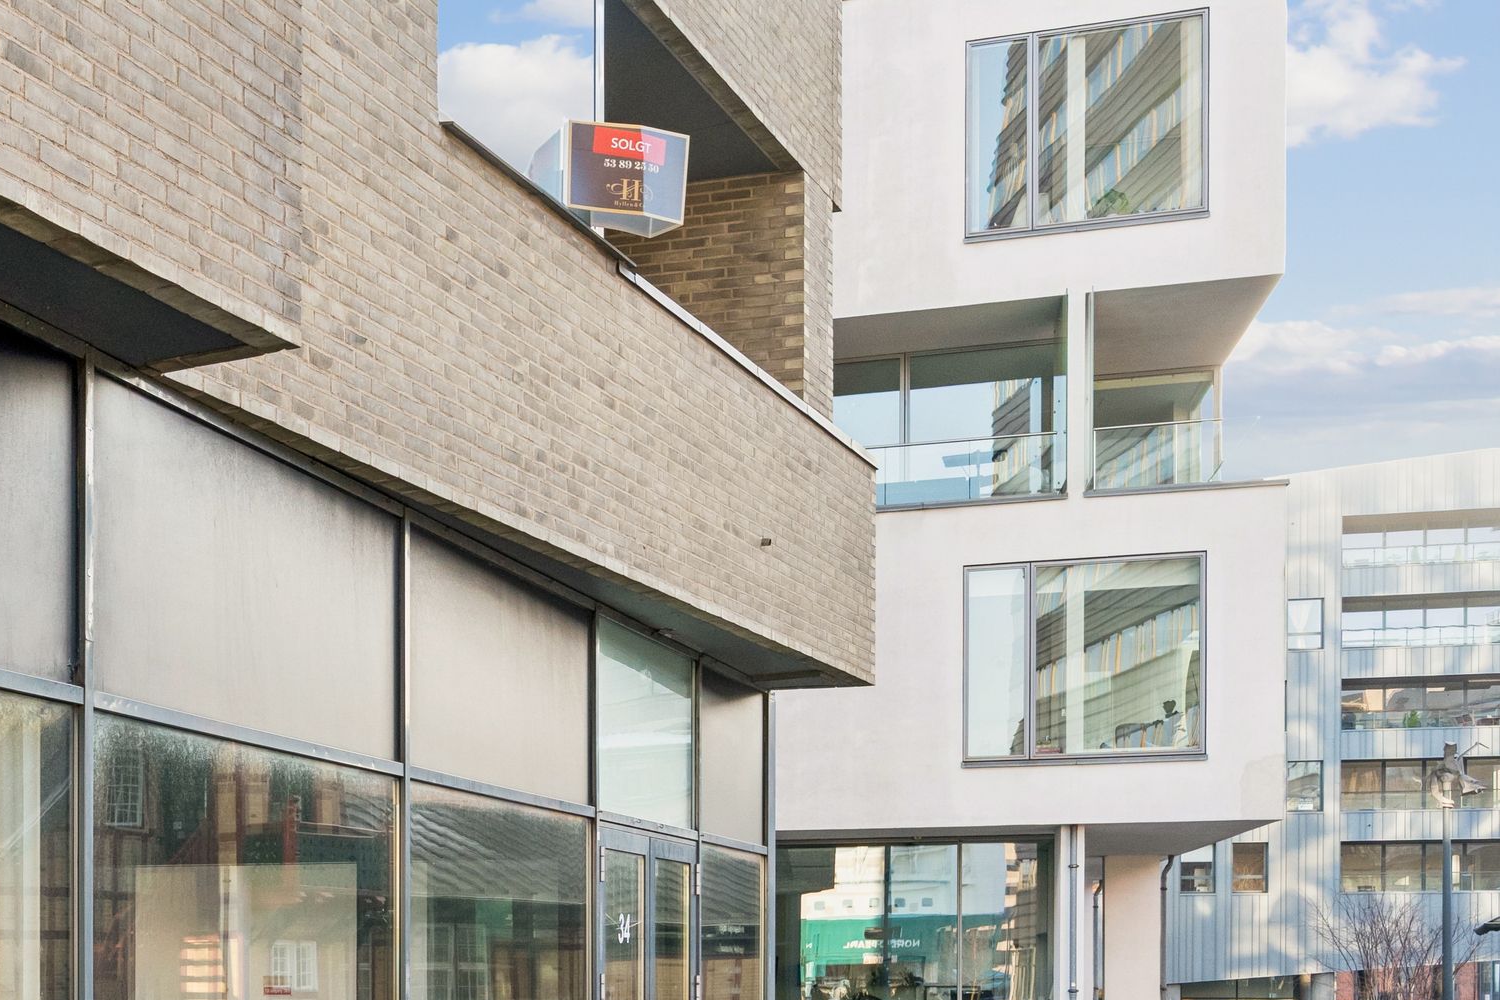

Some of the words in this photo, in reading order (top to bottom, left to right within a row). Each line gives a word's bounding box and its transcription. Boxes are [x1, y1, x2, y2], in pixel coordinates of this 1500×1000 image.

[611, 138, 652, 153] SOLGT
[603, 158, 616, 167] 53
[618, 160, 632, 169] 89
[618, 913, 630, 944] 34
